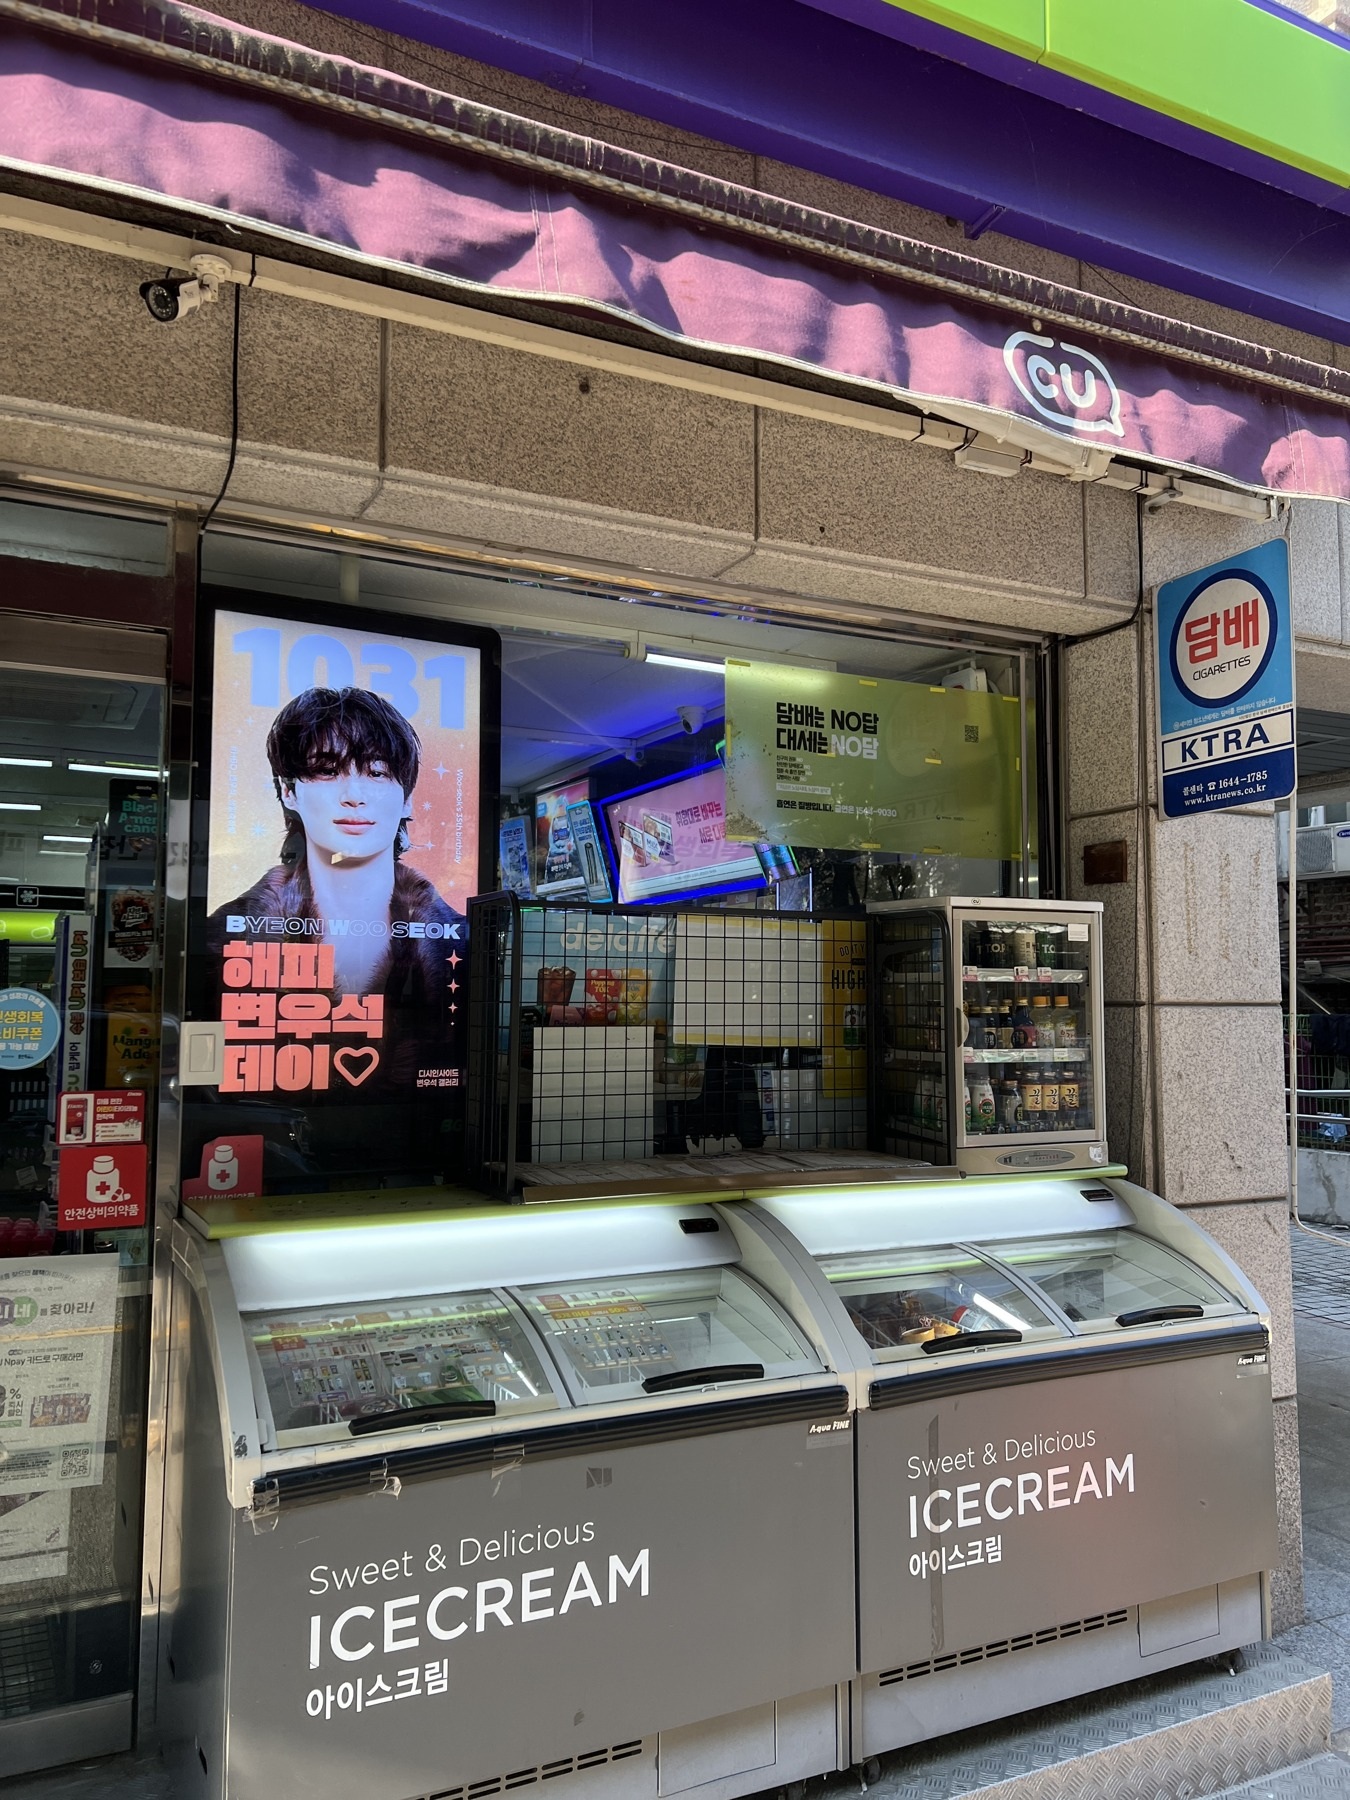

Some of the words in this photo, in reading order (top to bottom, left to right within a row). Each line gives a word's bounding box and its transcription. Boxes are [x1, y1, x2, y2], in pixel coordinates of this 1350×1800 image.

[1027, 354, 1096, 408] CU
[1185, 598, 1259, 664] 담배
[232, 627, 465, 730] 1031
[1193, 655, 1251, 681] CIGARETTES
[776, 702, 825, 729] 담배는
[776, 728, 828, 755] 대세는
[831, 734, 880, 760] NO담
[1181, 723, 1270, 763] KTRA
[1184, 784, 1267, 806] www.ktranews.co.kr
[1219, 770, 1268, 789] 1644-1785
[777, 799, 797, 809] 흡연은
[798, 801, 834, 812] 질병입니다.
[454, 831, 463, 864] birthday
[226, 915, 324, 935] BYEON
[329, 919, 387, 937] WOO
[391, 921, 461, 940] SEOK
[222, 940, 335, 988] 해피
[220, 993, 384, 1039] 변우석
[218, 1044, 330, 1092] 데이
[417, 1078, 437, 1088] 변우석
[438, 1078, 459, 1088] 갤러리
[418, 1069, 459, 1078] 디시인사이드
[64, 1204, 140, 1221] 안전상비의약품
[49, 1302, 95, 1316] 찾아라!
[4, 1358, 26, 1367] Npay
[27, 1355, 51, 1364] 카드로
[52, 1352, 84, 1362] 구매하면
[809, 1424, 831, 1434] Aqua
[832, 1420, 850, 1430] FINE
[906, 1448, 975, 1480] Sweet
[982, 1442, 998, 1465] &
[1005, 1428, 1097, 1462] Delicious
[909, 1453, 1136, 1539] ICECREAM
[308, 1551, 413, 1595] Sweet
[424, 1543, 447, 1573] &
[459, 1521, 596, 1567] Delicious
[908, 1534, 1003, 1580] 아이스크림
[308, 1548, 651, 1670] ICECREAM
[305, 1658, 449, 1720] 아이스크림
